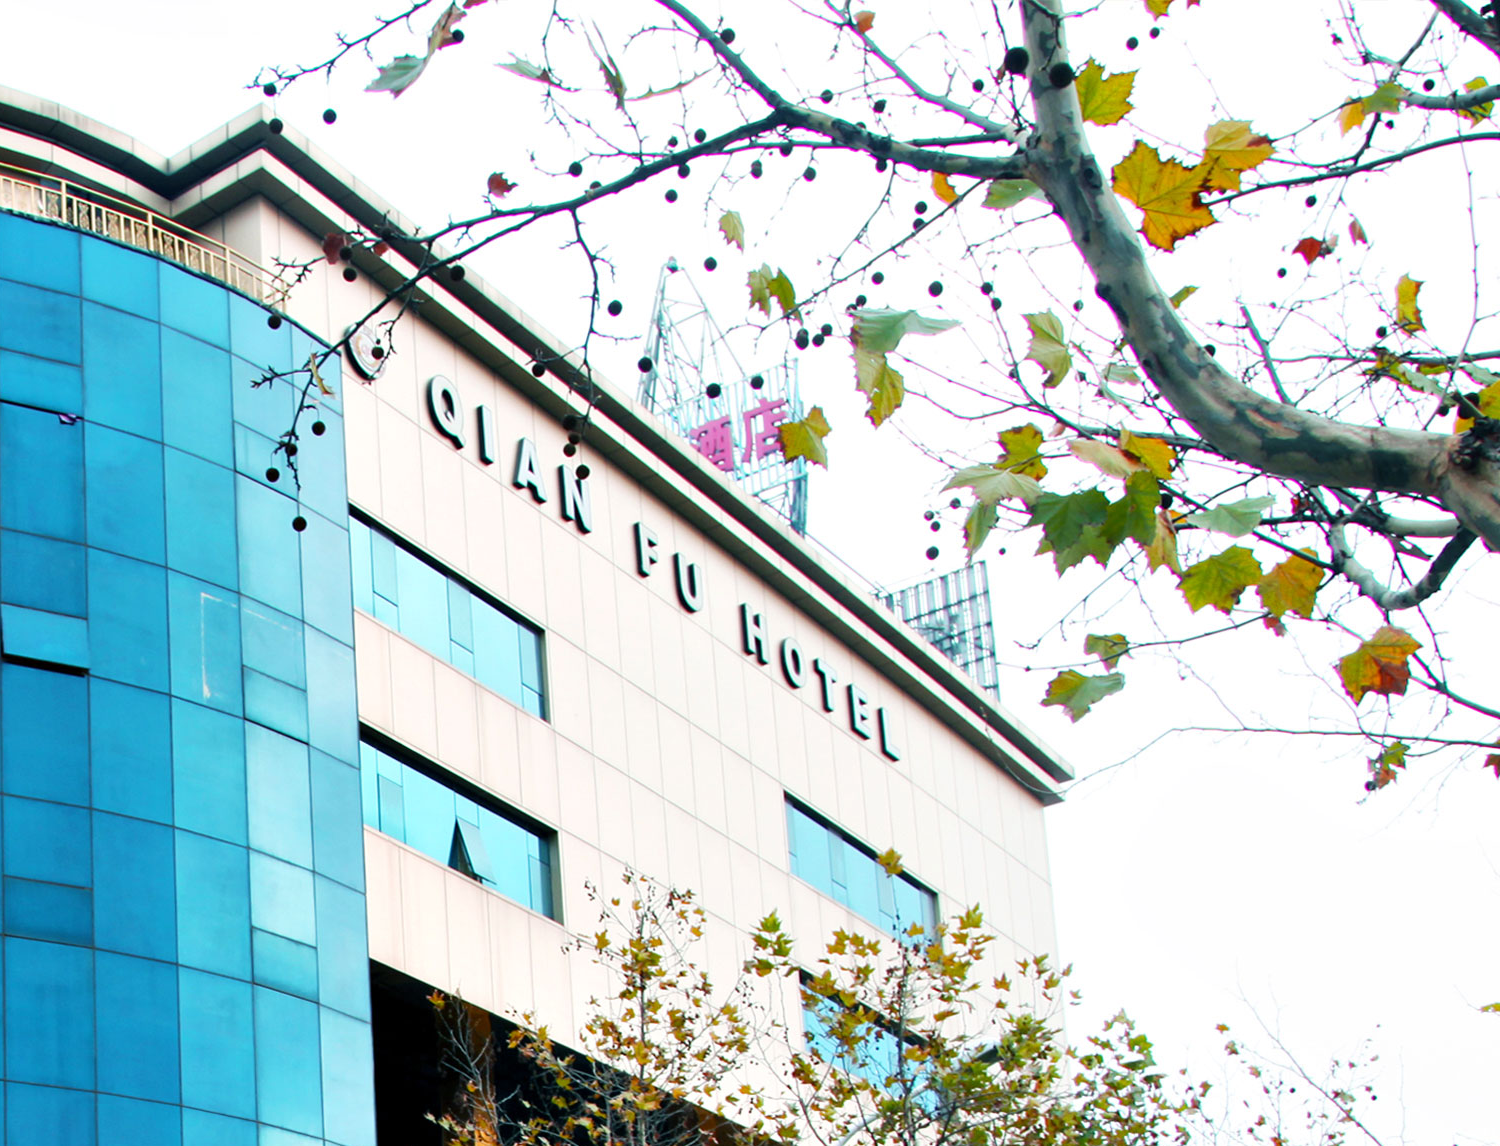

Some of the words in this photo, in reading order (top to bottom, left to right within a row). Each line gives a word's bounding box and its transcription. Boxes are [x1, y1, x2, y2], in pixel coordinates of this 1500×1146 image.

[425, 373, 592, 535] QIAN
[633, 521, 704, 613] FU
[740, 601, 901, 762] HOTEL
